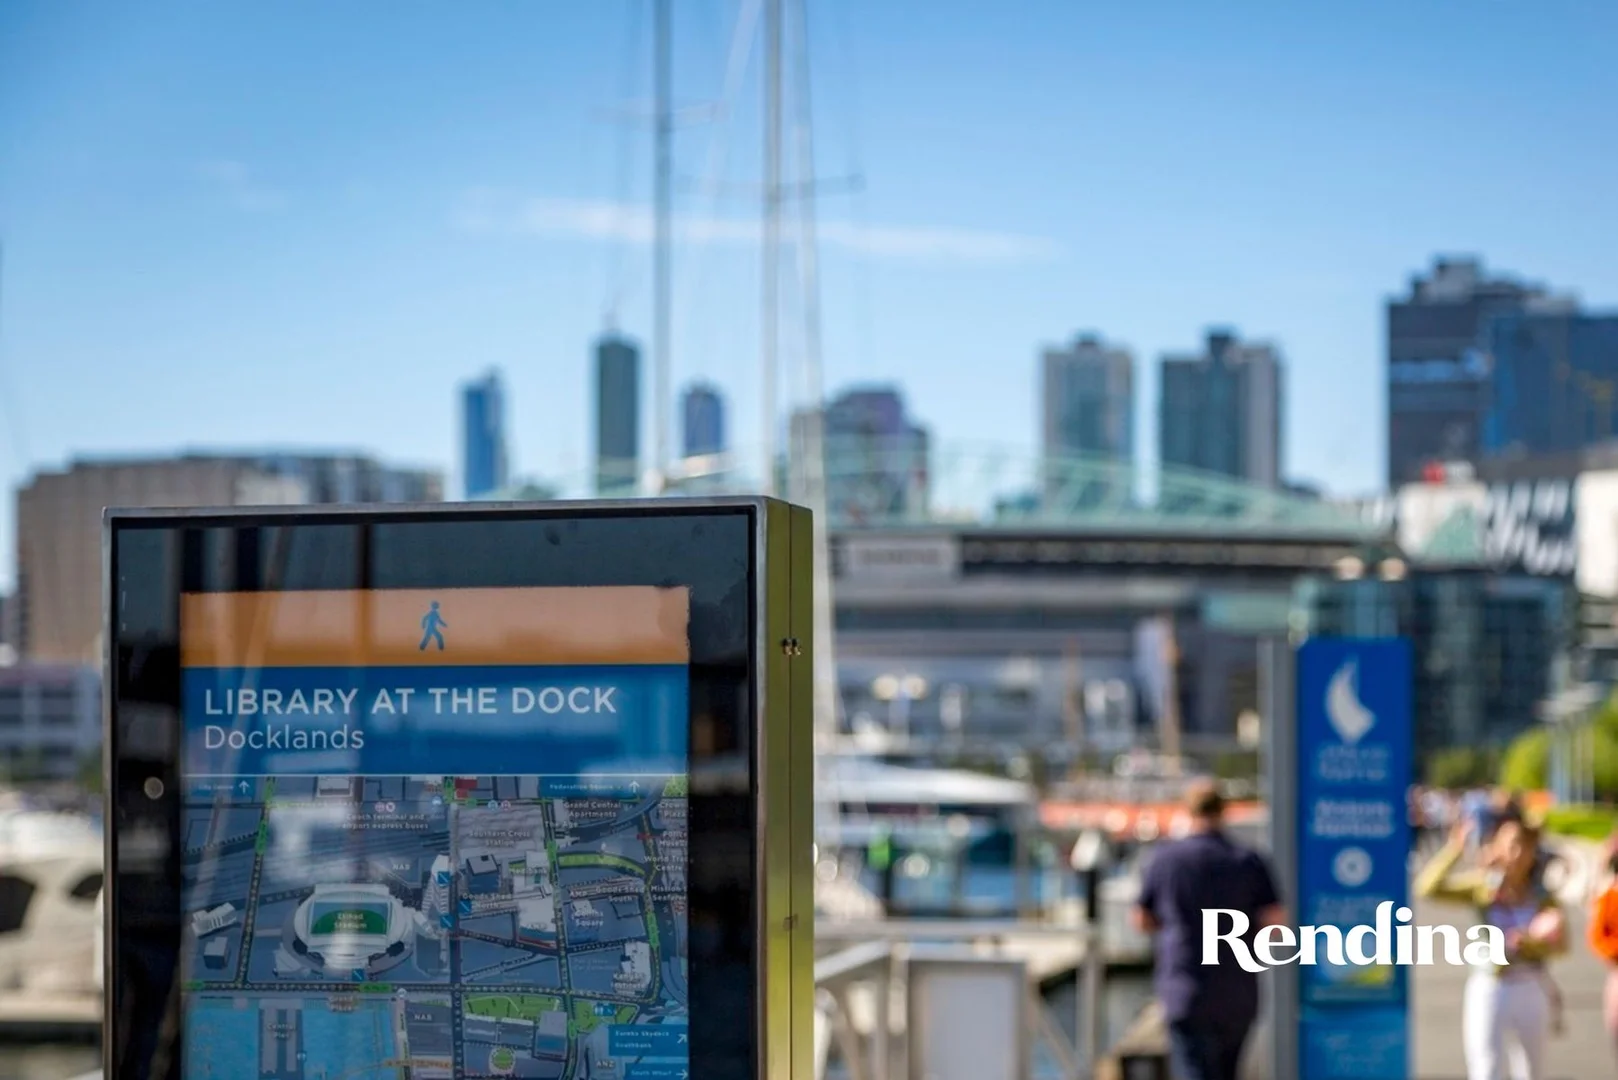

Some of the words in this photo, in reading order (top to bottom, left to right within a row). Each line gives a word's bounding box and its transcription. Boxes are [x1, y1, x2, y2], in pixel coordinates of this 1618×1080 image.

[204, 687, 360, 715] LIBRARY
[371, 687, 416, 714] AT
[428, 687, 498, 714] THE
[511, 686, 618, 714] DOCK
[204, 724, 366, 750] Docklands
[563, 800, 589, 810] Grand
[591, 800, 622, 810] Central
[409, 813, 425, 822] and
[568, 810, 617, 819] Apartments
[413, 1013, 433, 1022] NAB
[595, 1059, 615, 1069] ANZ
